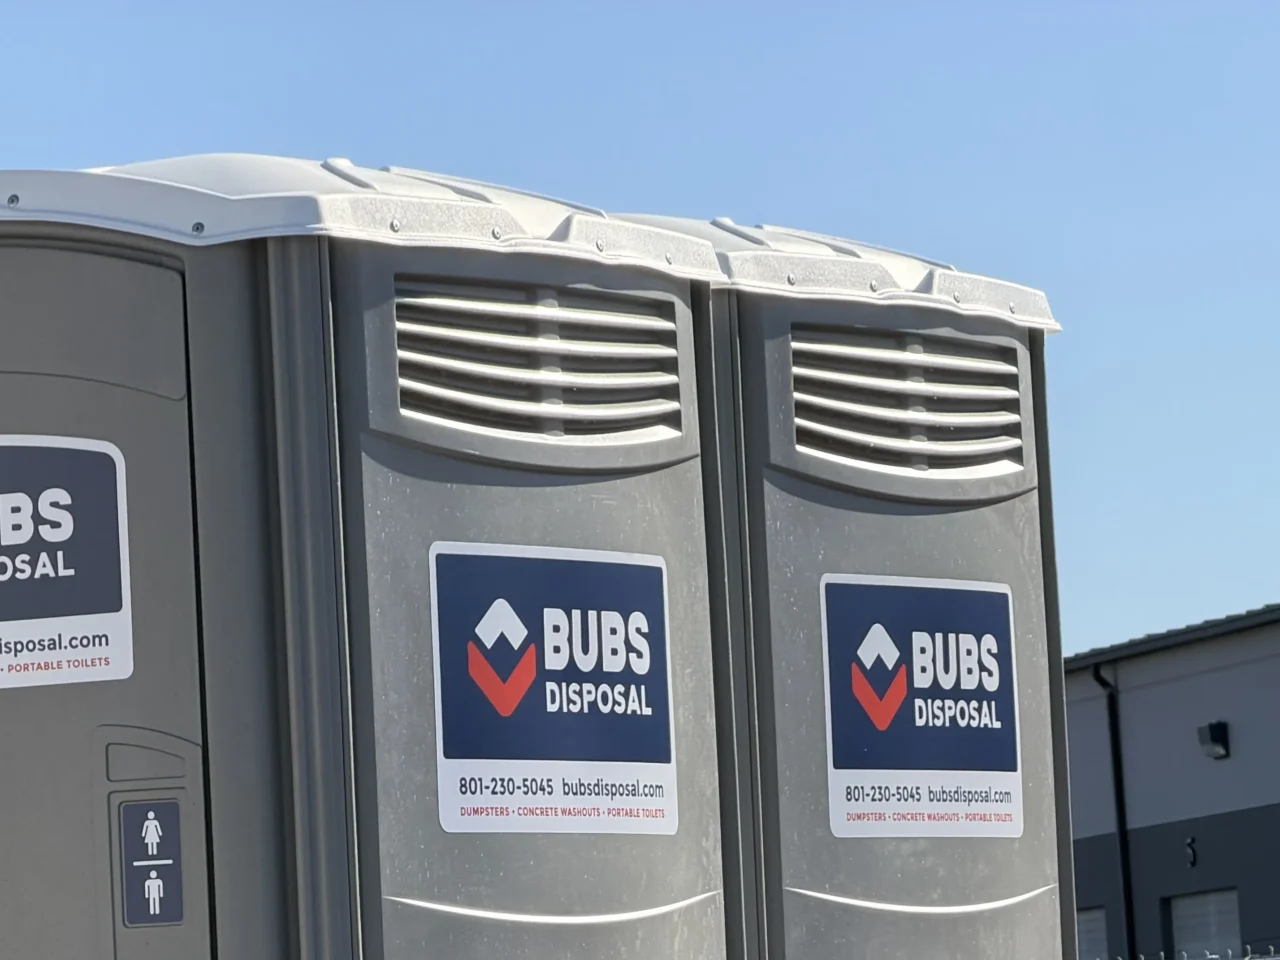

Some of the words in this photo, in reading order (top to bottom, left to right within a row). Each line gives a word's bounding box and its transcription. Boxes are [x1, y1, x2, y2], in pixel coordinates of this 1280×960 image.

[543, 607, 651, 675] BUBS
[7, 660, 63, 674] PORTABLE
[66, 656, 110, 669] TOILETS
[912, 631, 1000, 692] BUBS
[545, 681, 652, 716] DISPOSAL
[914, 698, 1002, 729] DISPOSAL
[459, 777, 554, 796] 801-230-5045
[562, 777, 664, 801] bubsdisposal.com
[845, 785, 922, 803] 801-230-5045
[928, 785, 1012, 807] bubsdisposal.com
[460, 806, 510, 817] DUMPSTERS
[517, 806, 559, 817] CONCRETE
[560, 807, 601, 817] WASHOUTS
[607, 807, 641, 818] PORTABLE
[642, 808, 665, 819] TOILETS
[846, 812, 887, 822] DUMPSTERS
[892, 812, 926, 822] CONCRETE
[927, 812, 960, 822] WASHOUTS
[965, 813, 993, 822] PORTABLE
[993, 813, 1013, 822] TOILETS
